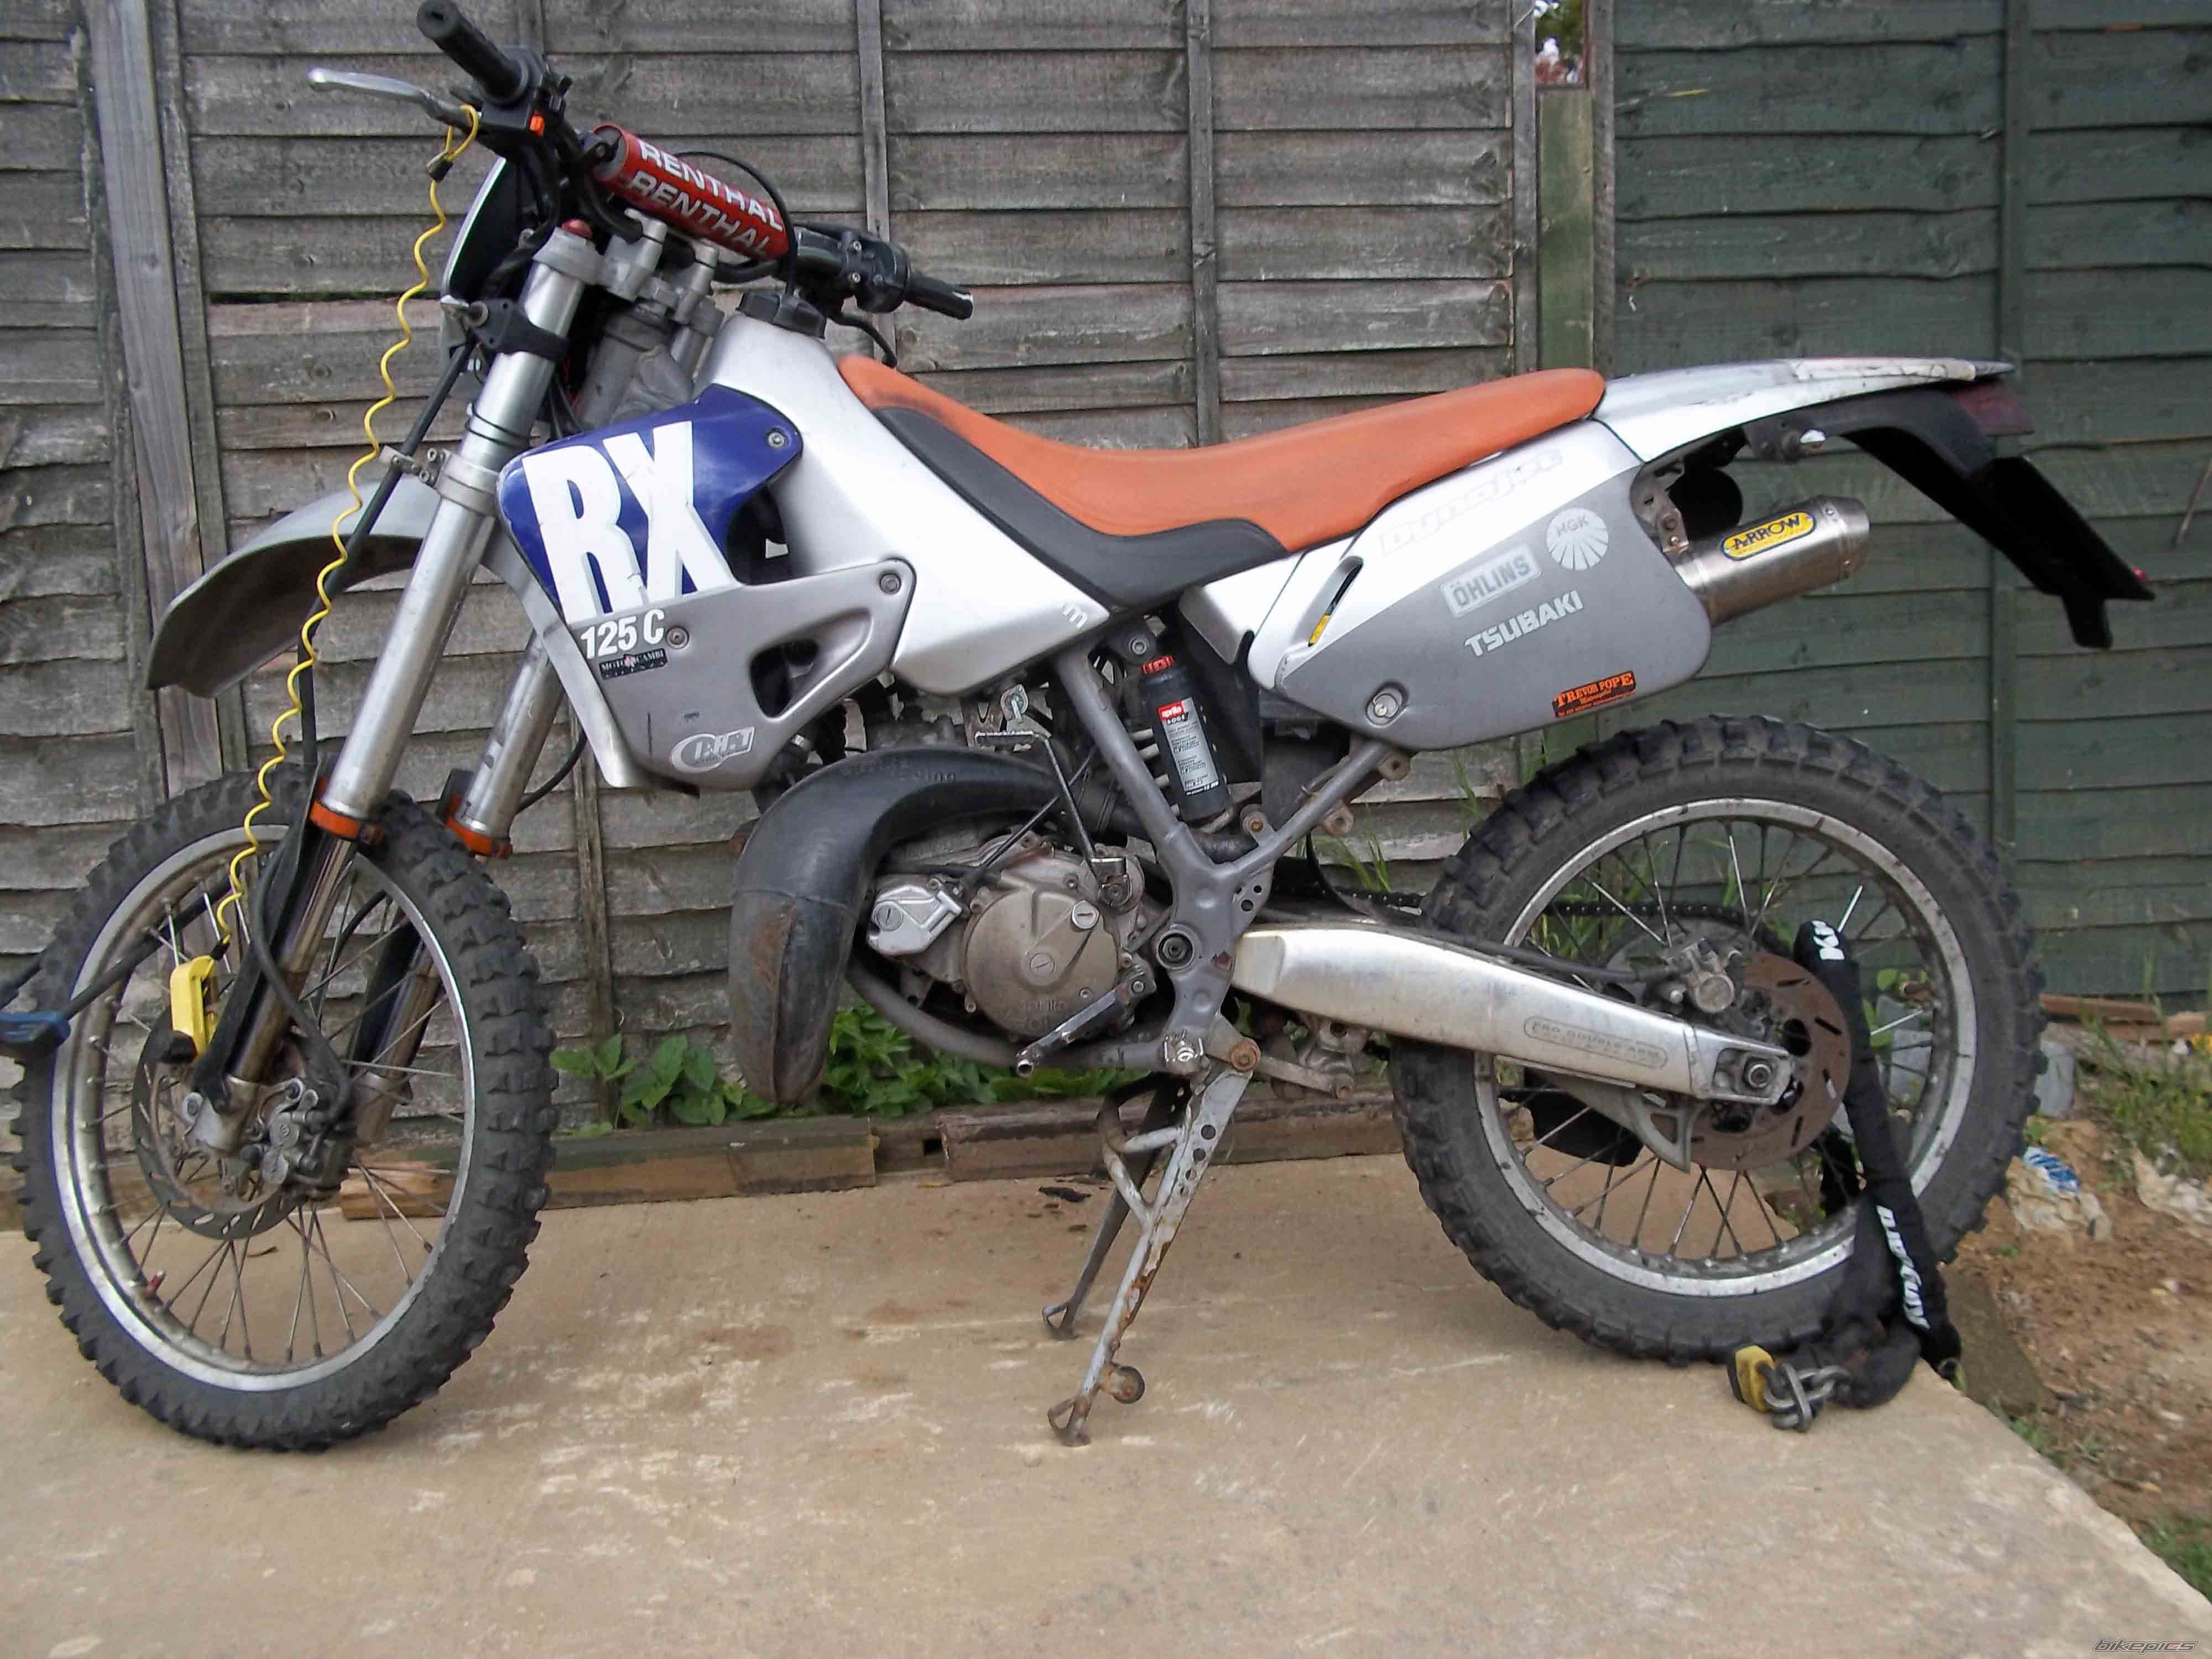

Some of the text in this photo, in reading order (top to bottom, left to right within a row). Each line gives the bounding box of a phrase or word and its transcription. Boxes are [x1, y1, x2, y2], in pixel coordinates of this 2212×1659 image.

[626, 170, 771, 256] RENTHAL
[638, 139, 783, 232] RENTHAL
[521, 420, 744, 624] RX
[1733, 514, 1801, 550] ARROW
[581, 609, 665, 659] 125 C
[1464, 589, 1584, 657] TSUBAKI
[1557, 682, 1599, 707] TREVOR
[1598, 672, 1634, 691] POPE
